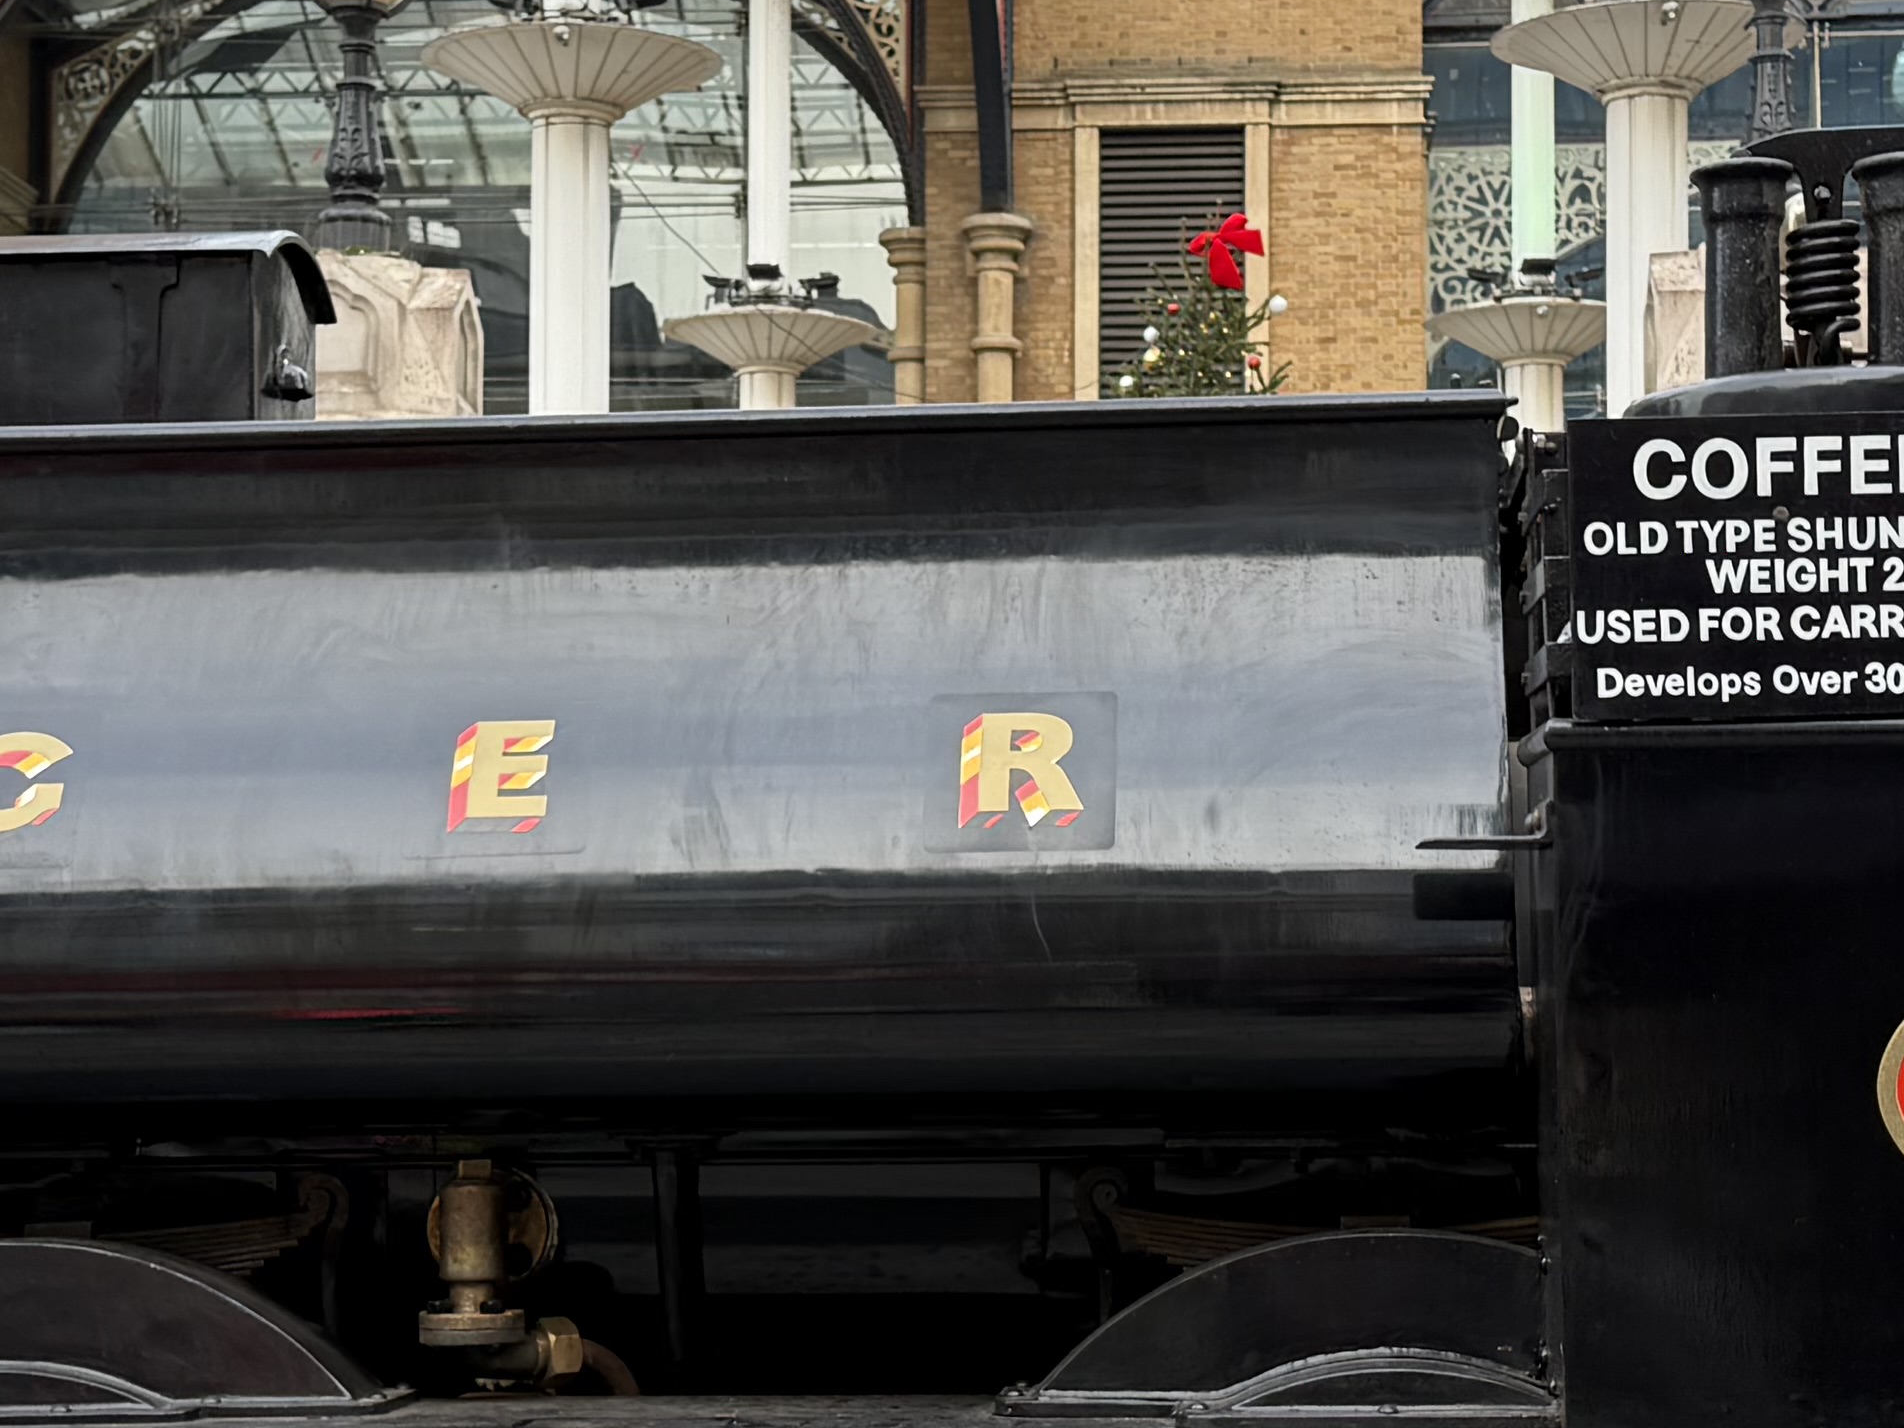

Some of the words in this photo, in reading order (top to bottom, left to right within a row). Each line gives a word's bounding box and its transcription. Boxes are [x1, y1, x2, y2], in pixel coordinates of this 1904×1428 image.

[1583, 521, 1669, 556] OLD
[1676, 518, 1776, 553] TYPE
[1705, 556, 1874, 594] WEIGHT
[1576, 608, 1690, 644] USED
[1698, 607, 1782, 641] FOR
[1596, 667, 1762, 703] Develops
[1772, 665, 1858, 695] Over
[446, 719, 557, 834] E
[958, 712, 1085, 829] R
